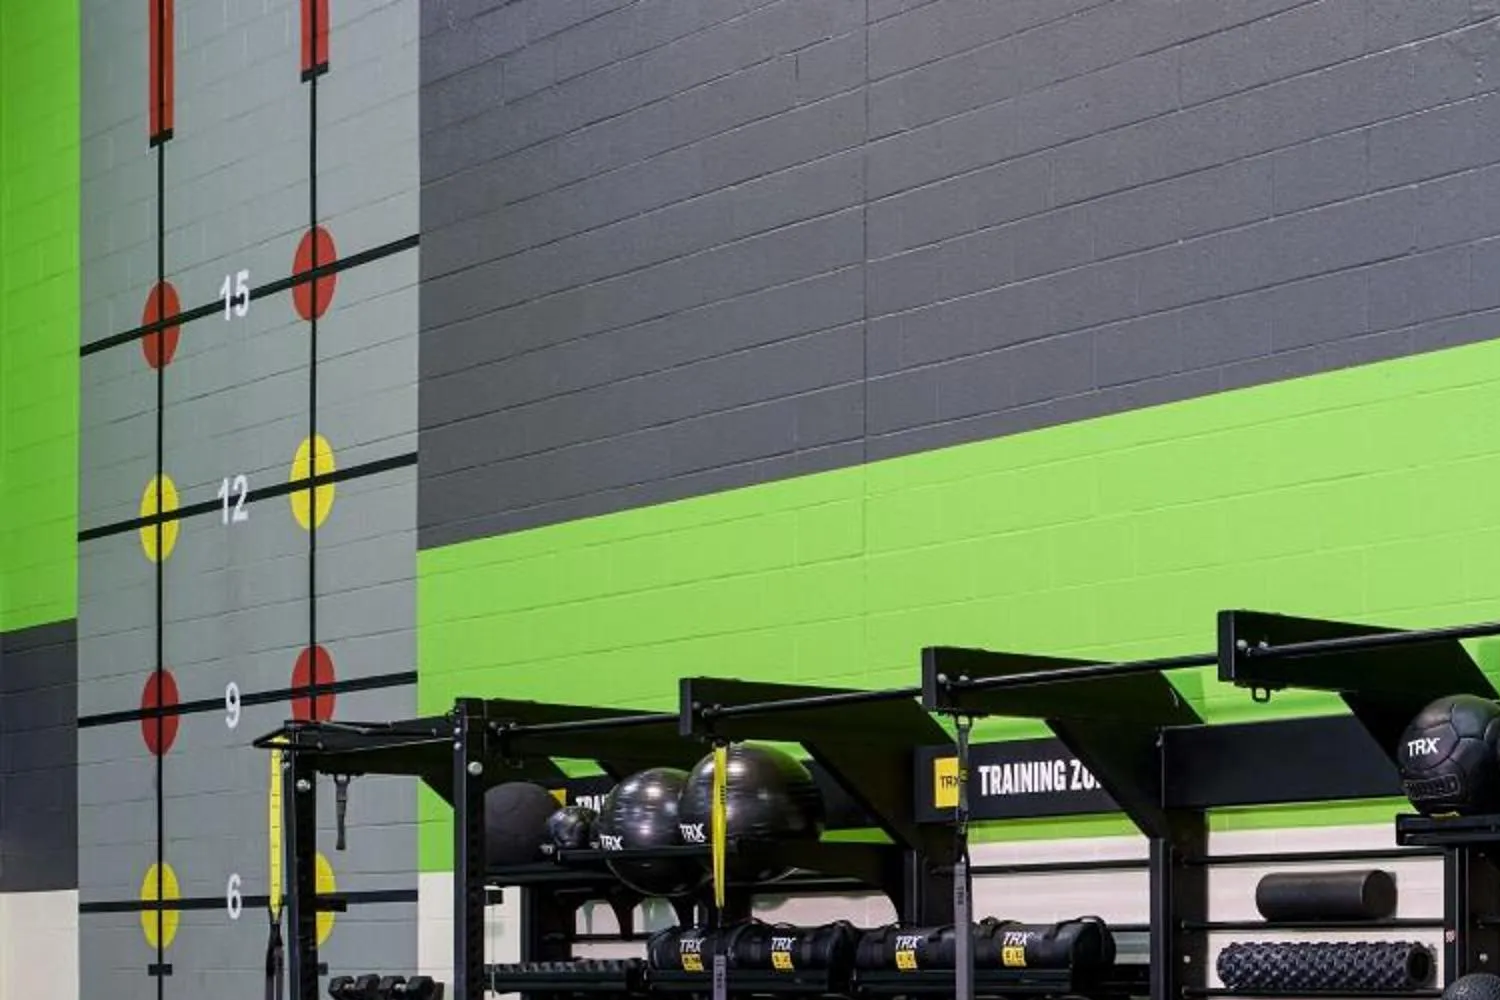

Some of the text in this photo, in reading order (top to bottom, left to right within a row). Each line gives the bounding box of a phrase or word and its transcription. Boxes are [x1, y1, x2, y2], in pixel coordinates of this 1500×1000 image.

[219, 269, 250, 321] 15
[217, 474, 249, 525] 12
[225, 681, 241, 729] 9
[1407, 736, 1440, 758] TRX
[977, 758, 1102, 797] TRAINING ZO
[600, 833, 624, 851] TRX
[680, 823, 705, 843] TRX
[226, 872, 242, 920] 6
[680, 937, 706, 953] TRX
[771, 936, 797, 951] TRX
[896, 935, 923, 950] TRX
[1002, 931, 1034, 946] TRX
